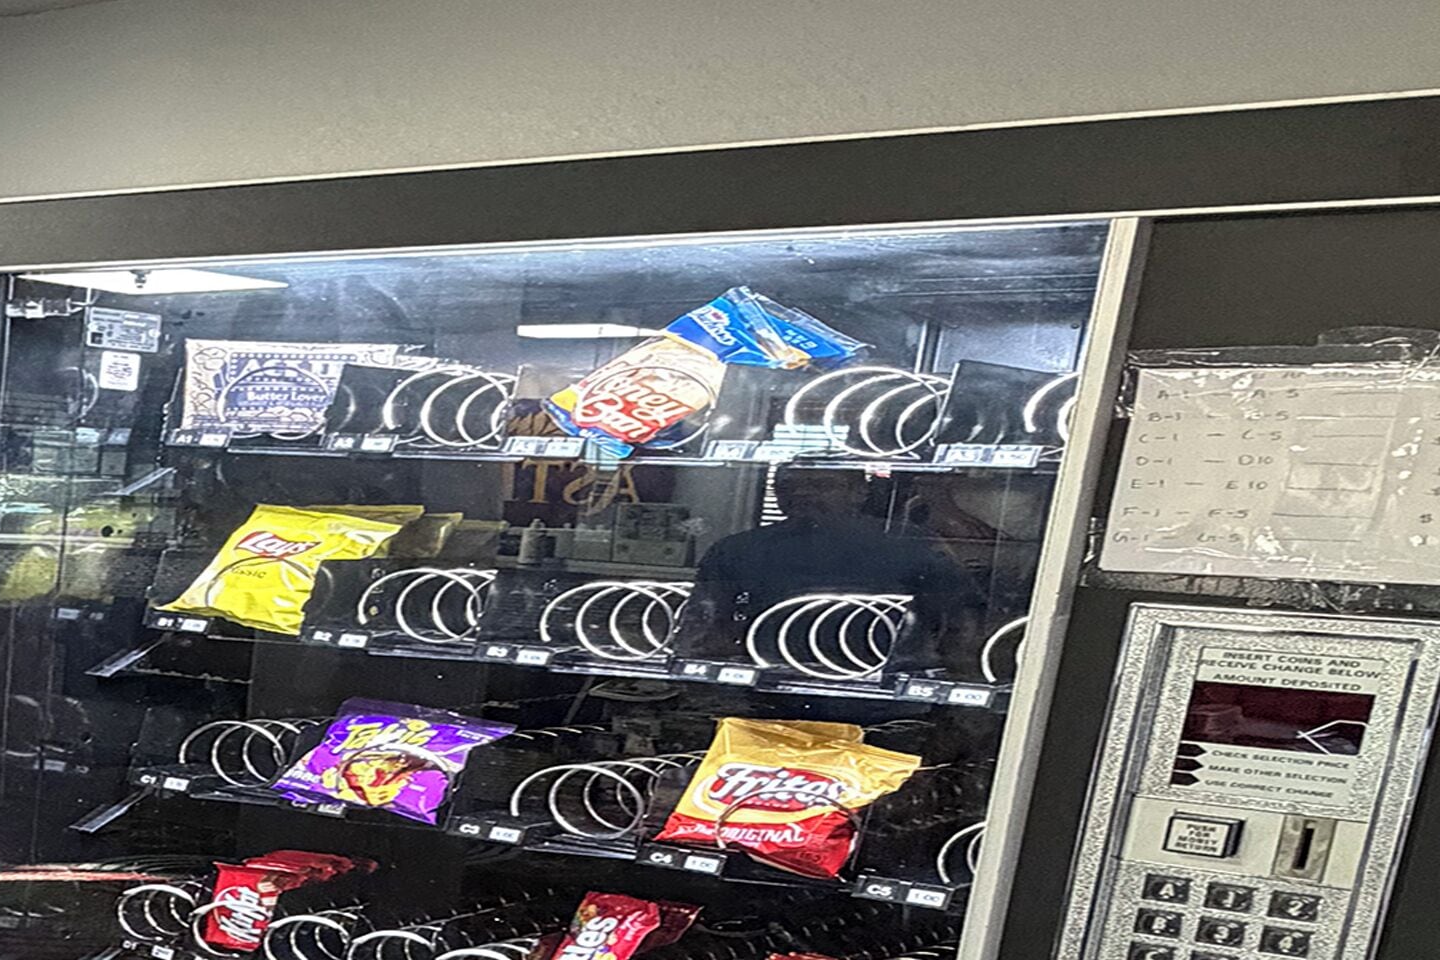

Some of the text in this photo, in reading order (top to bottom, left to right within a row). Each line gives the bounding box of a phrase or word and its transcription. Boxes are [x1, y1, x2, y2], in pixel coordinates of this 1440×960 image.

[1223, 651, 1361, 669] INSERT COINS AND
[1201, 659, 1381, 680] RECEIVE CHANGE BELOW
[907, 684, 935, 698] B5
[1213, 673, 1362, 693] AMOUNT DEPOSITED
[335, 719, 439, 755] Takis
[1211, 749, 1351, 770] CHECK SELECTION PRICE
[1208, 764, 1349, 786] MAKE OTHER SELECTION
[708, 762, 858, 808] Fritos
[1204, 779, 1336, 799] USE CORRECT CHANGE
[459, 823, 481, 835] C3
[1185, 823, 1218, 833] PUSH
[1175, 842, 1219, 854] RETURN
[1177, 835, 1219, 847] MONEY
[649, 851, 673, 864] C4
[866, 883, 893, 897] C5
[1159, 882, 1176, 900] A
[1227, 890, 1237, 907] 1
[1288, 902, 1304, 918] 2
[1151, 915, 1168, 934] B
[1213, 925, 1229, 942] 3
[1278, 936, 1295, 953] 4
